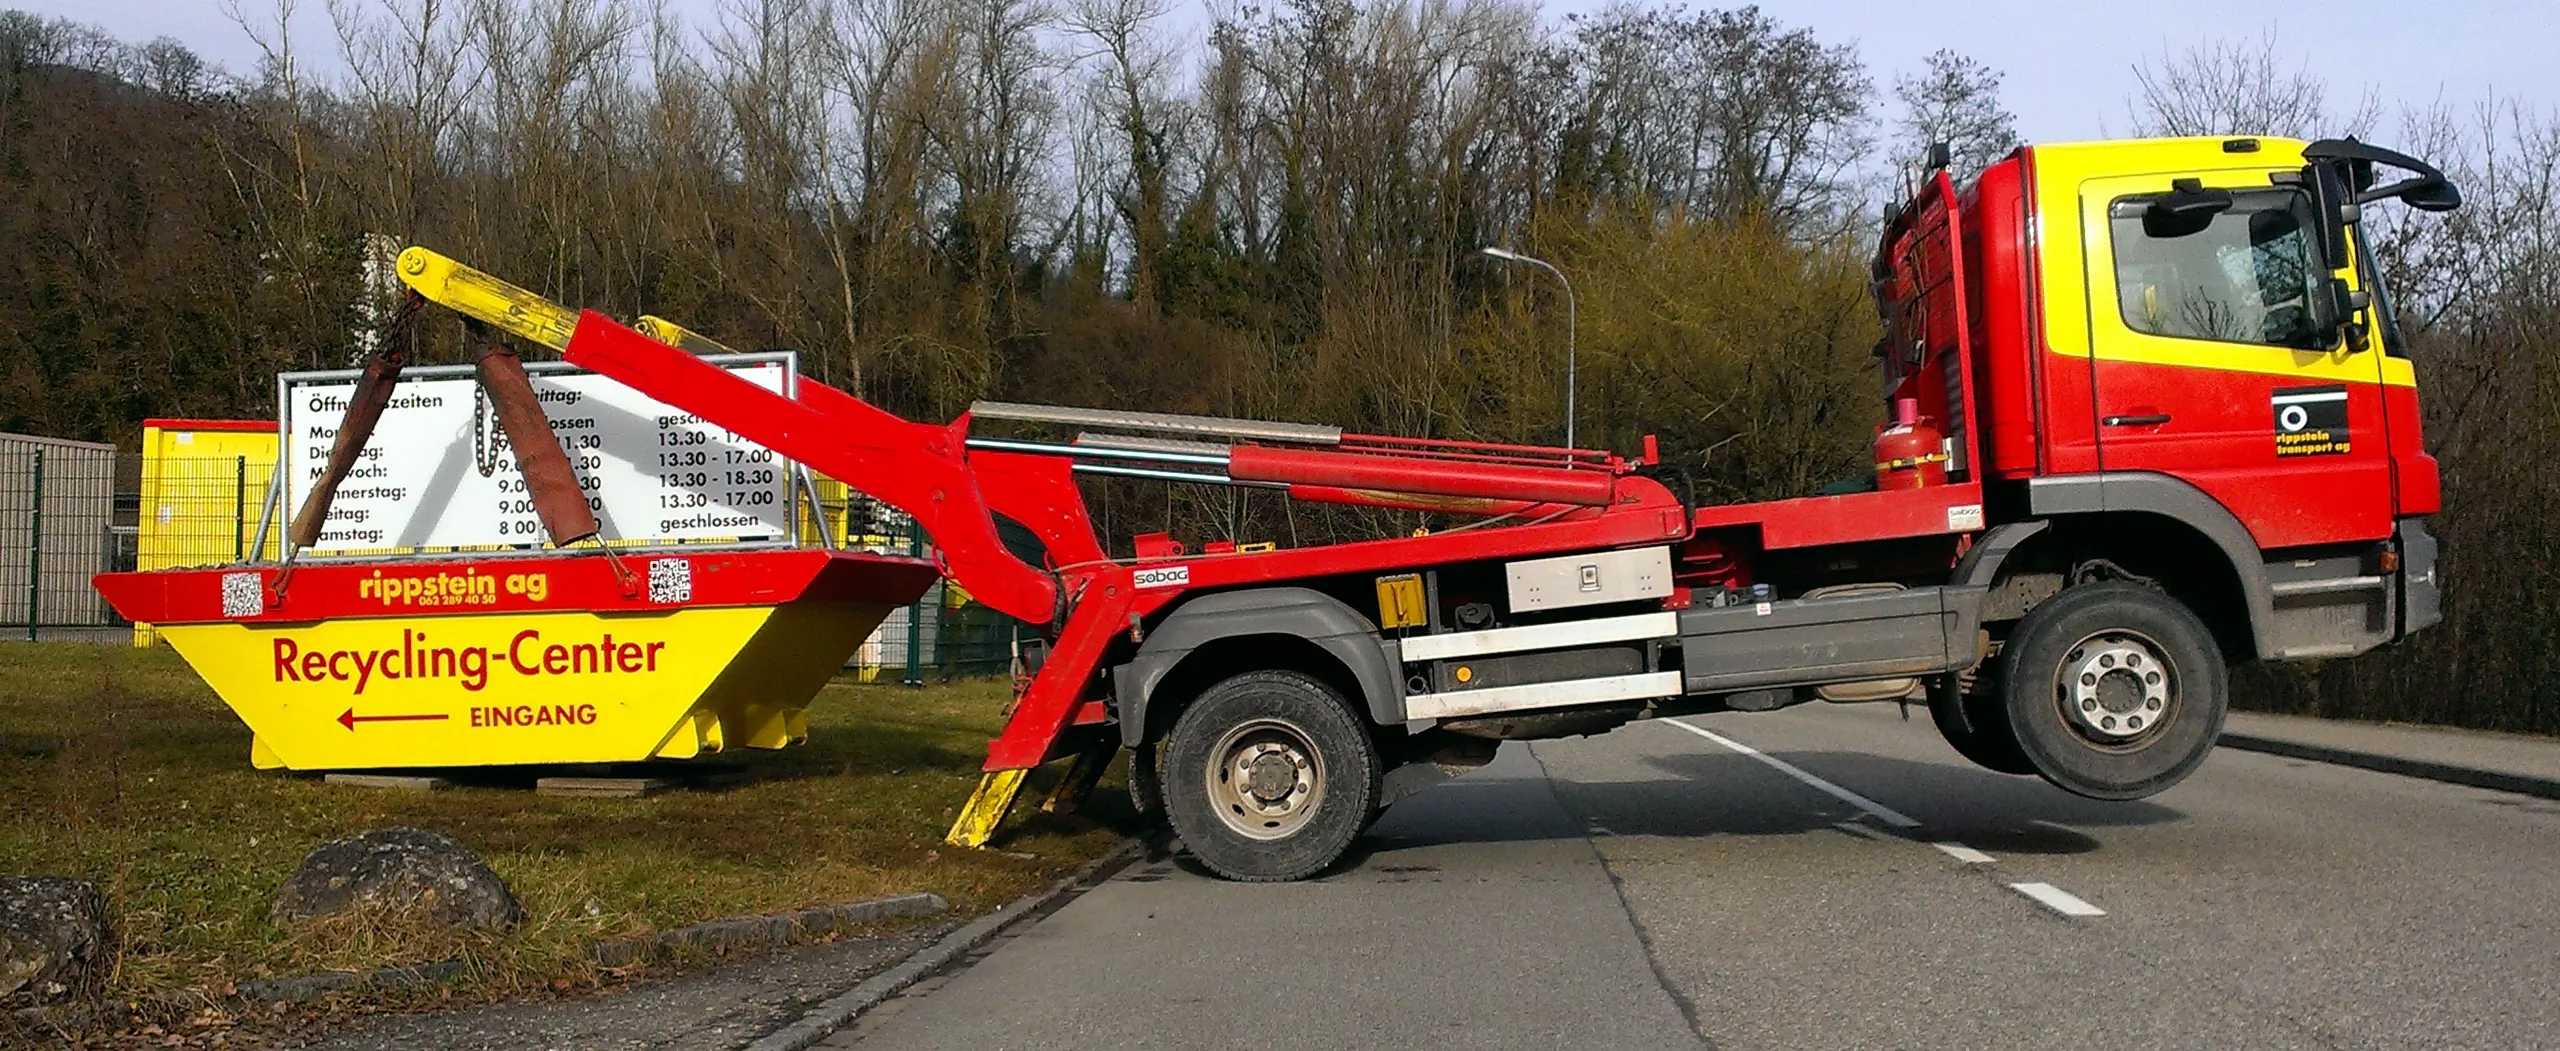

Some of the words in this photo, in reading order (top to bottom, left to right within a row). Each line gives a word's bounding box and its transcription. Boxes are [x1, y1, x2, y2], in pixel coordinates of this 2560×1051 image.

[309, 393, 443, 413] Öffnszeiten
[535, 388, 582, 405] ittag:
[659, 431, 706, 447] 13.30
[2276, 430, 2330, 445] rippstein
[2276, 442, 2333, 455] transport
[2334, 443, 2351, 453] ag
[659, 452, 706, 467] 13.30
[725, 449, 773, 465] 17.00
[660, 472, 707, 488] 13.30
[725, 469, 773, 485] 18.30
[334, 487, 406, 501] nnerstag:
[660, 493, 707, 508] 13.30
[726, 490, 773, 506] 17.00
[325, 506, 369, 523] eitag:
[499, 499, 536, 514] 9.00
[660, 513, 759, 533] geschlossen
[319, 528, 383, 543] amstag:
[359, 567, 496, 606] rippstein
[505, 573, 547, 602] ag
[419, 596, 440, 606] 062
[443, 595, 463, 605] 289
[465, 594, 479, 604] 40
[481, 594, 496, 604] 50
[273, 628, 665, 696] Recycling-Center
[470, 704, 597, 729] EINGANG
